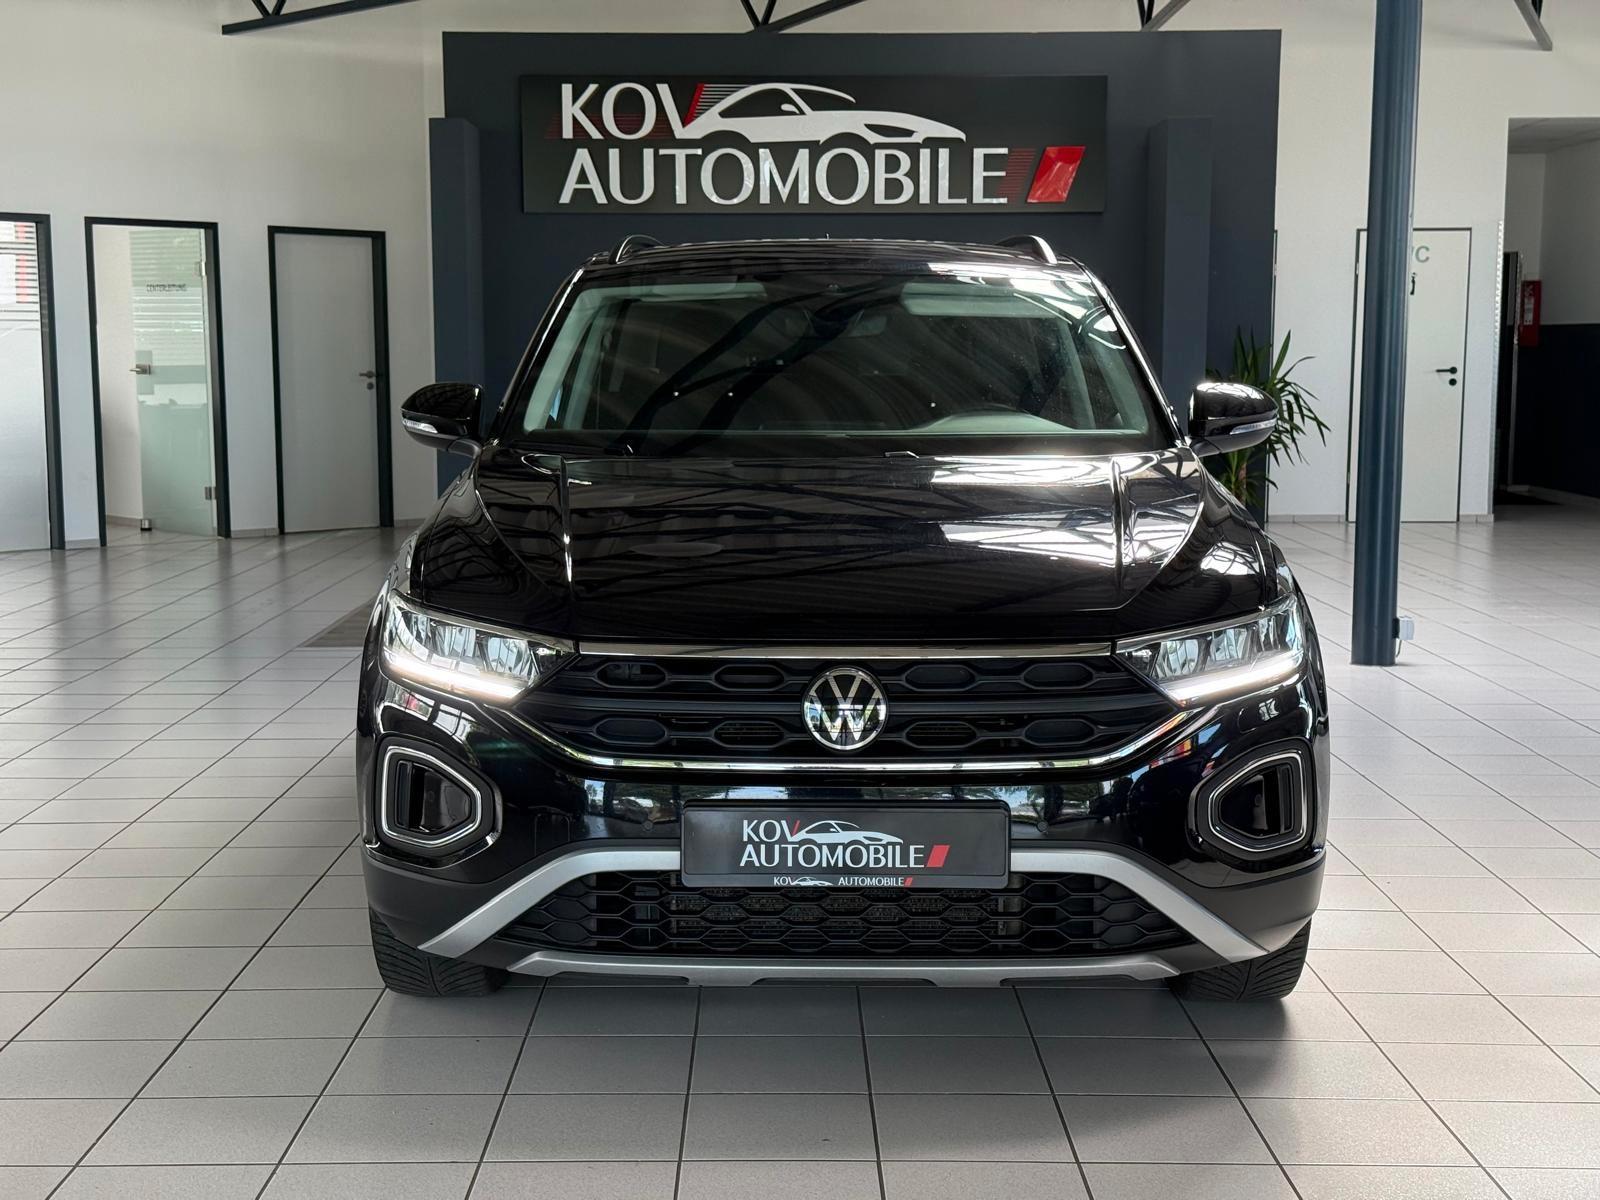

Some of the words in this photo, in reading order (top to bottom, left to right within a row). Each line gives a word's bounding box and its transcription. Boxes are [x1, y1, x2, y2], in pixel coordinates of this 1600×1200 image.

[561, 83, 706, 139] KOV
[559, 148, 1008, 204] AUTOMOBILE
[743, 820, 800, 841] KOV
[740, 845, 924, 867] AUTOMOBILE
[773, 876, 796, 886] KOV
[838, 876, 905, 886] AUTOMOBILE
